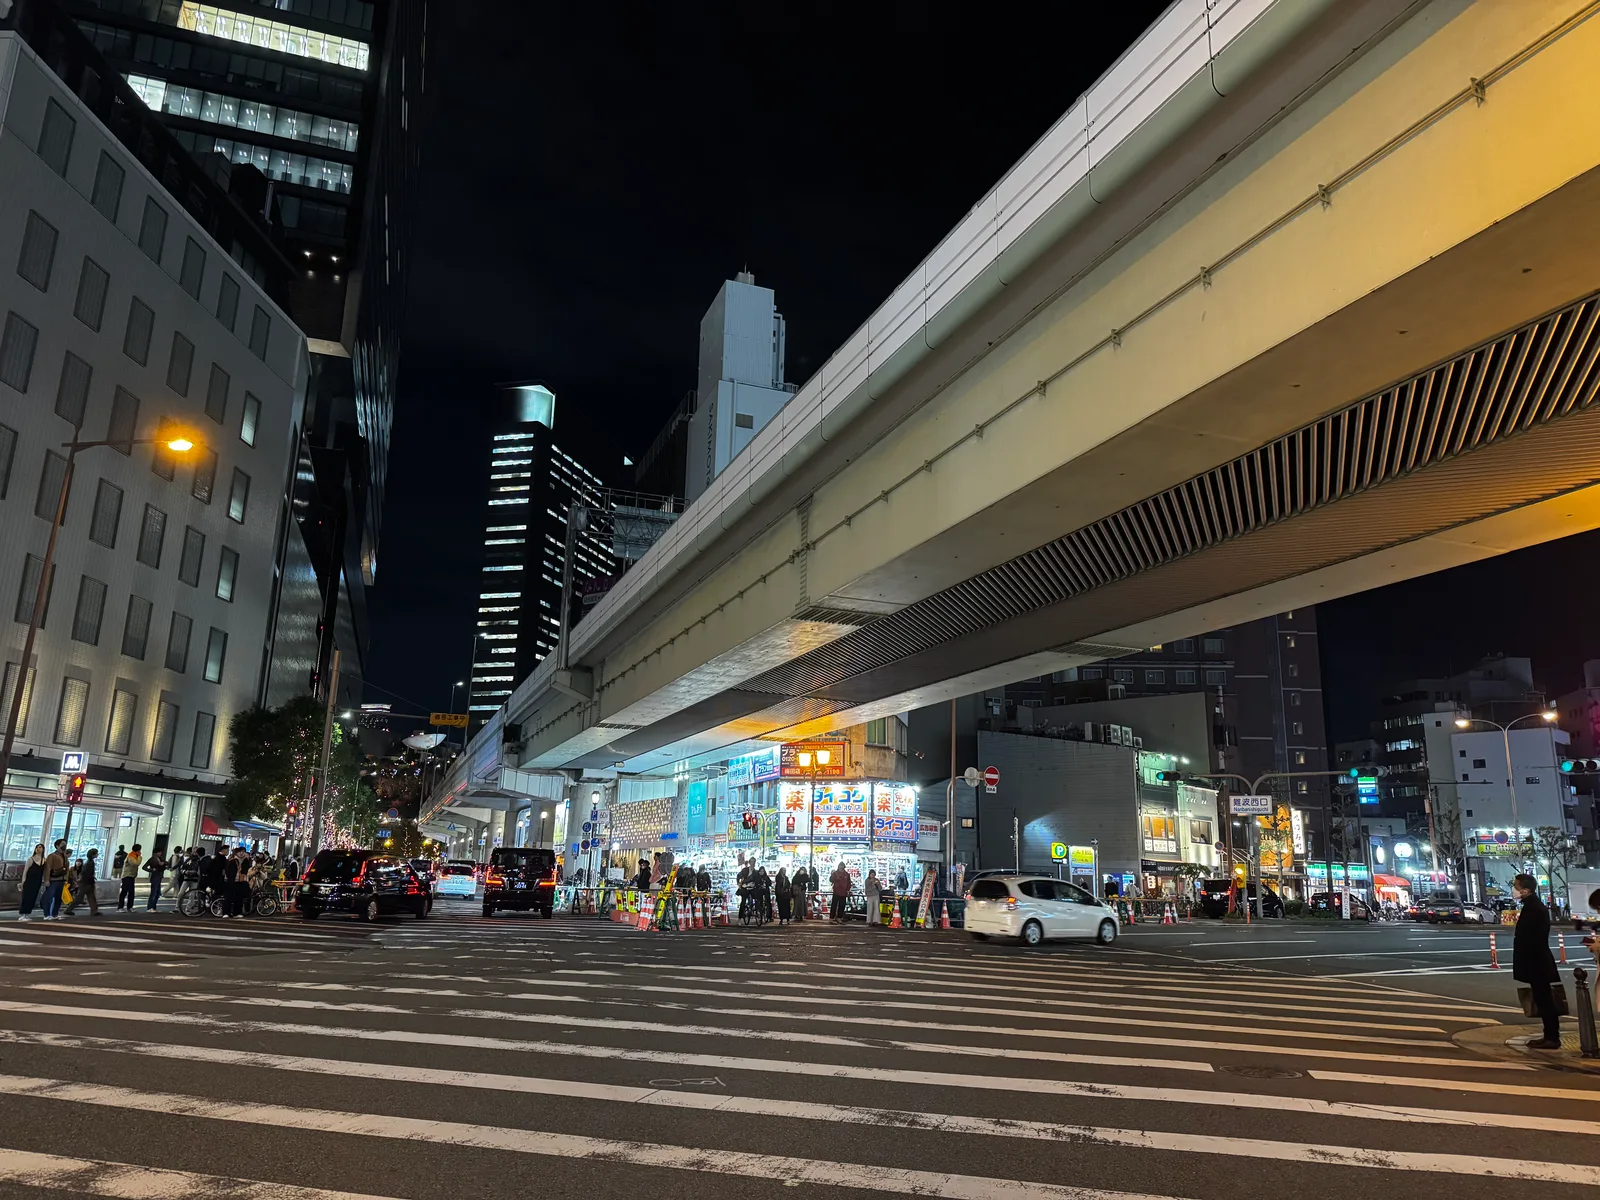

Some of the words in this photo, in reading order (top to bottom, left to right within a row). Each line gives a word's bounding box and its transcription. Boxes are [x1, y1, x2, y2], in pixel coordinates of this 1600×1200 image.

[1233, 798, 1268, 806] 難波西口
[826, 815, 865, 828] 免税
[875, 818, 913, 831] ダイコク
